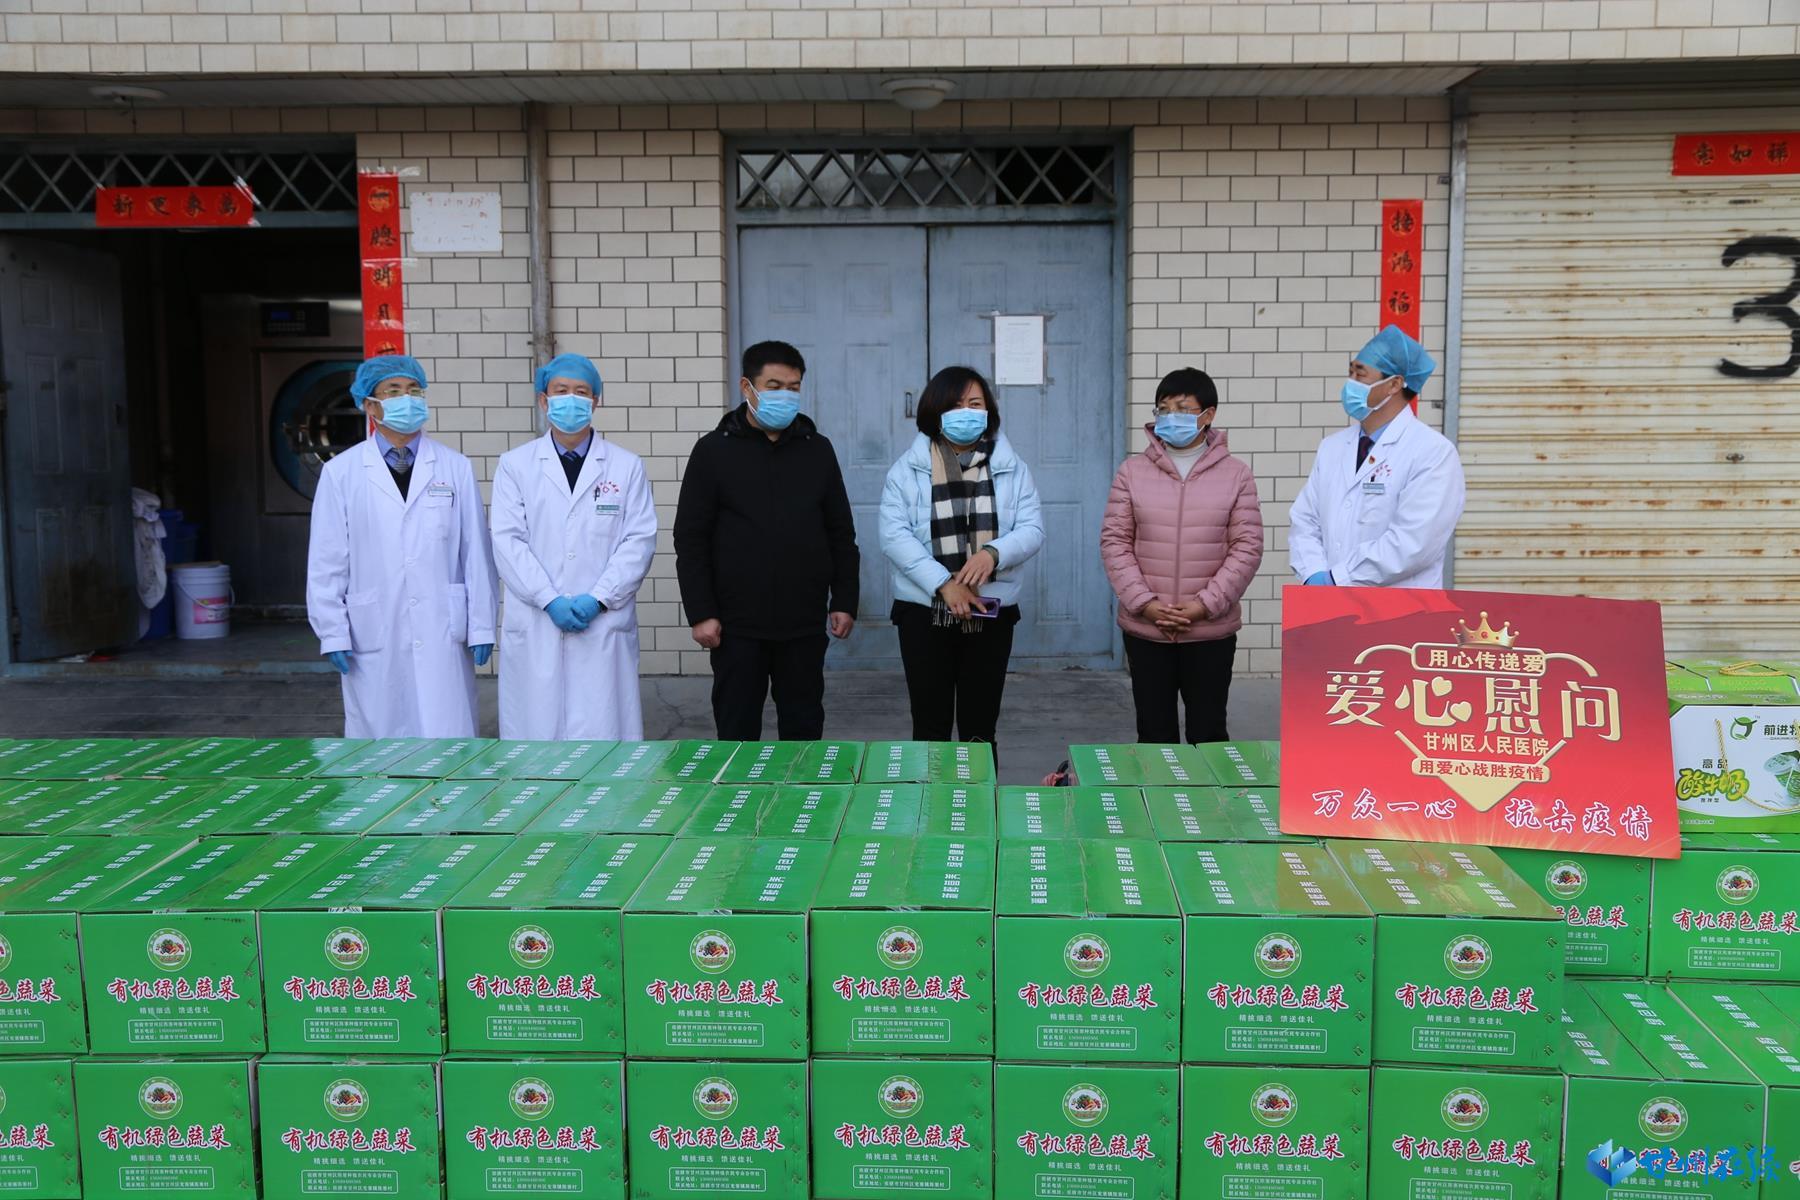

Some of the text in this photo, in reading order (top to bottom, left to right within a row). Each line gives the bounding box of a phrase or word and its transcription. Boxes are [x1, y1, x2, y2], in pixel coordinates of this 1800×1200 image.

[1716, 236, 1800, 380] 3
[1428, 649, 1546, 673] 用心传递爱
[1325, 669, 1622, 741] 爱心慰问
[1423, 731, 1550, 757] 甘州区人民医院
[1417, 759, 1545, 781] 用爱心战胜疫情
[1312, 788, 1457, 822] 万众一心
[1504, 798, 1653, 841] 抗击疫情
[1672, 908, 1800, 935] 有机绿色蔬菜
[107, 975, 240, 1004] 有机绿色蔬菜
[283, 975, 417, 1003] 有机绿色蔬菜
[467, 974, 601, 1001] 有机绿色蔬菜
[646, 979, 783, 1006] 有机绿色蔬菜
[833, 975, 970, 1002] 有机绿色蔬菜
[1018, 982, 1158, 1010] 有机绿色蔬菜
[1206, 983, 1349, 1012] 有机绿色蔬菜
[1394, 983, 1540, 1014] 有机绿色蔬菜
[98, 1123, 231, 1152] 有机绿色蔬菜
[281, 1127, 416, 1154] 有机绿色蔬菜
[466, 1125, 601, 1152] 有机绿色蔬菜
[650, 1125, 785, 1152] 有机绿色蔬菜
[834, 1123, 970, 1150] 有机绿色蔬菜
[1016, 1131, 1156, 1161] 有机绿色蔬菜
[1203, 1132, 1345, 1160] 有机绿色蔬菜
[1391, 1134, 1537, 1167] 有机绿色蔬菜
